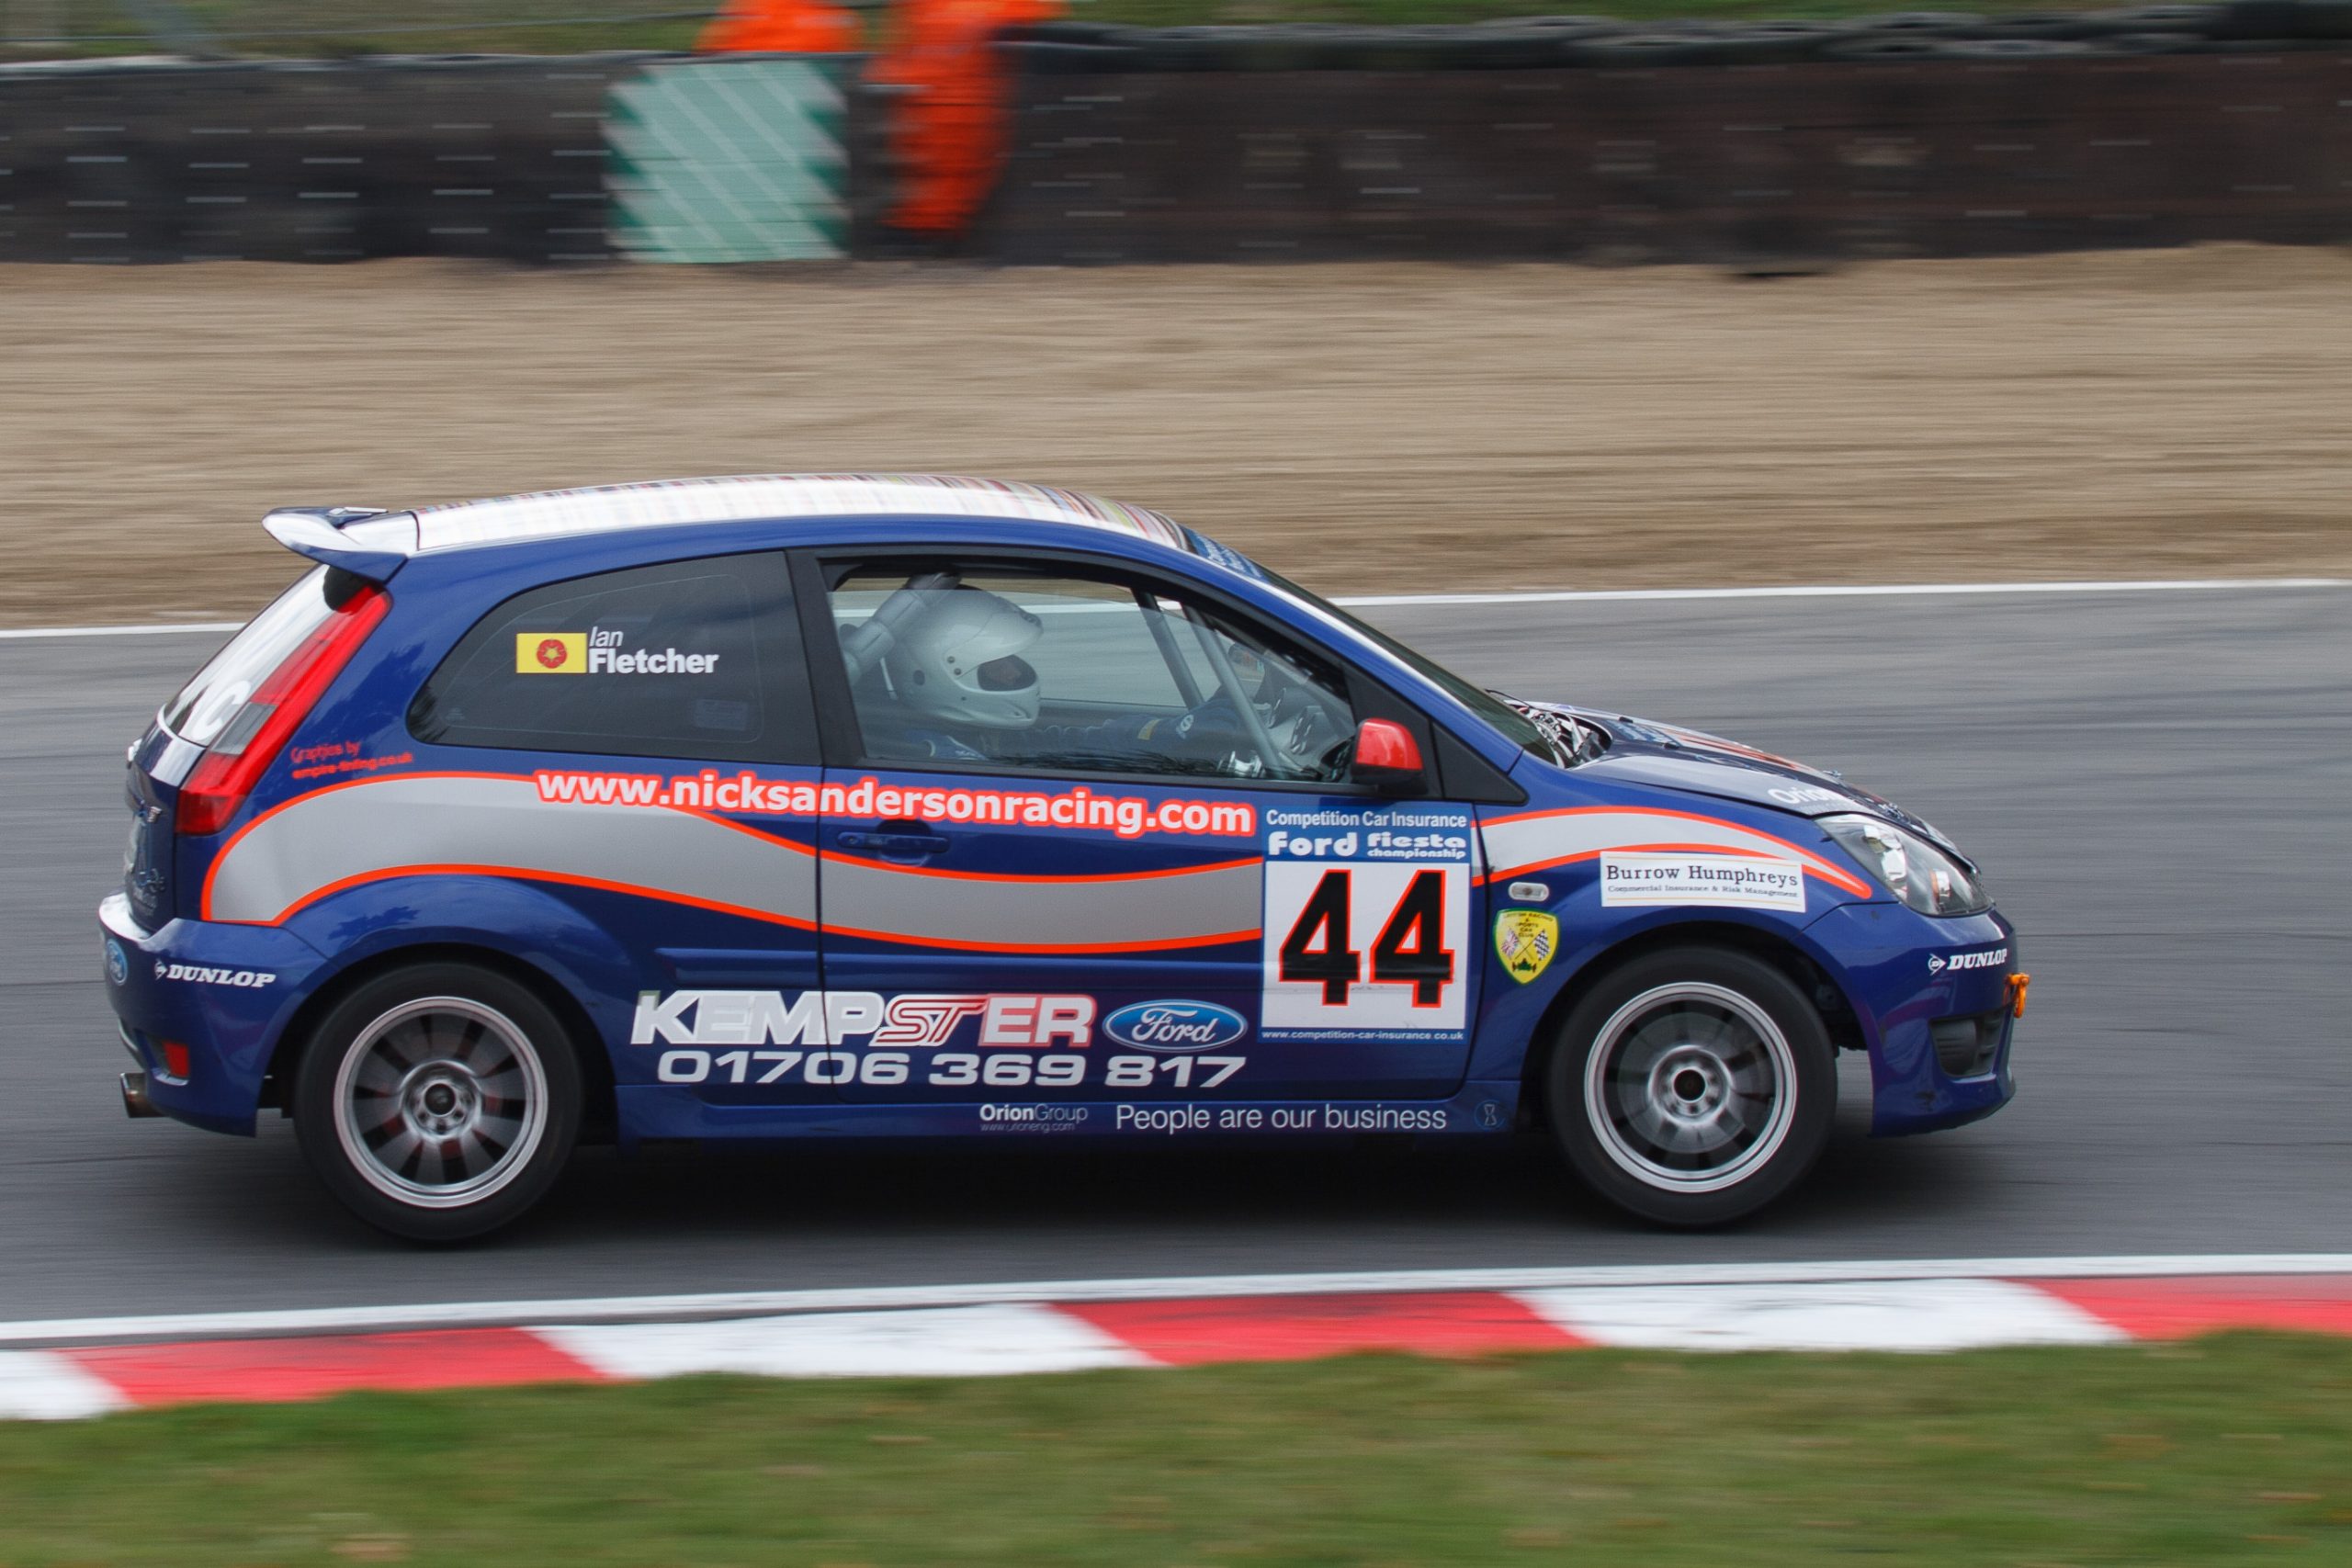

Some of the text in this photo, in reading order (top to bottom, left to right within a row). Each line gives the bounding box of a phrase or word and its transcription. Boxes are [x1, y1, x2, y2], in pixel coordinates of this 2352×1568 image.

[589, 626, 624, 647] Ian
[589, 649, 719, 673] Fletcher
[537, 771, 1253, 837] www.nicksandersonracing.com
[1266, 809, 1467, 829] Competition Car Insurance
[1367, 848, 1466, 859] championship
[1606, 865, 1798, 888] Burrow Humphreys
[1745, 887, 1798, 897] Management
[1279, 869, 1454, 1008] 44
[1947, 948, 2007, 970] DUNLOP
[167, 964, 276, 988] DUNLOP
[630, 990, 1098, 1047] KEMPSTER
[1132, 1008, 1220, 1043] Ford
[657, 1050, 1246, 1089] 01706 369 817
[1116, 1104, 1447, 1134] People are our business
